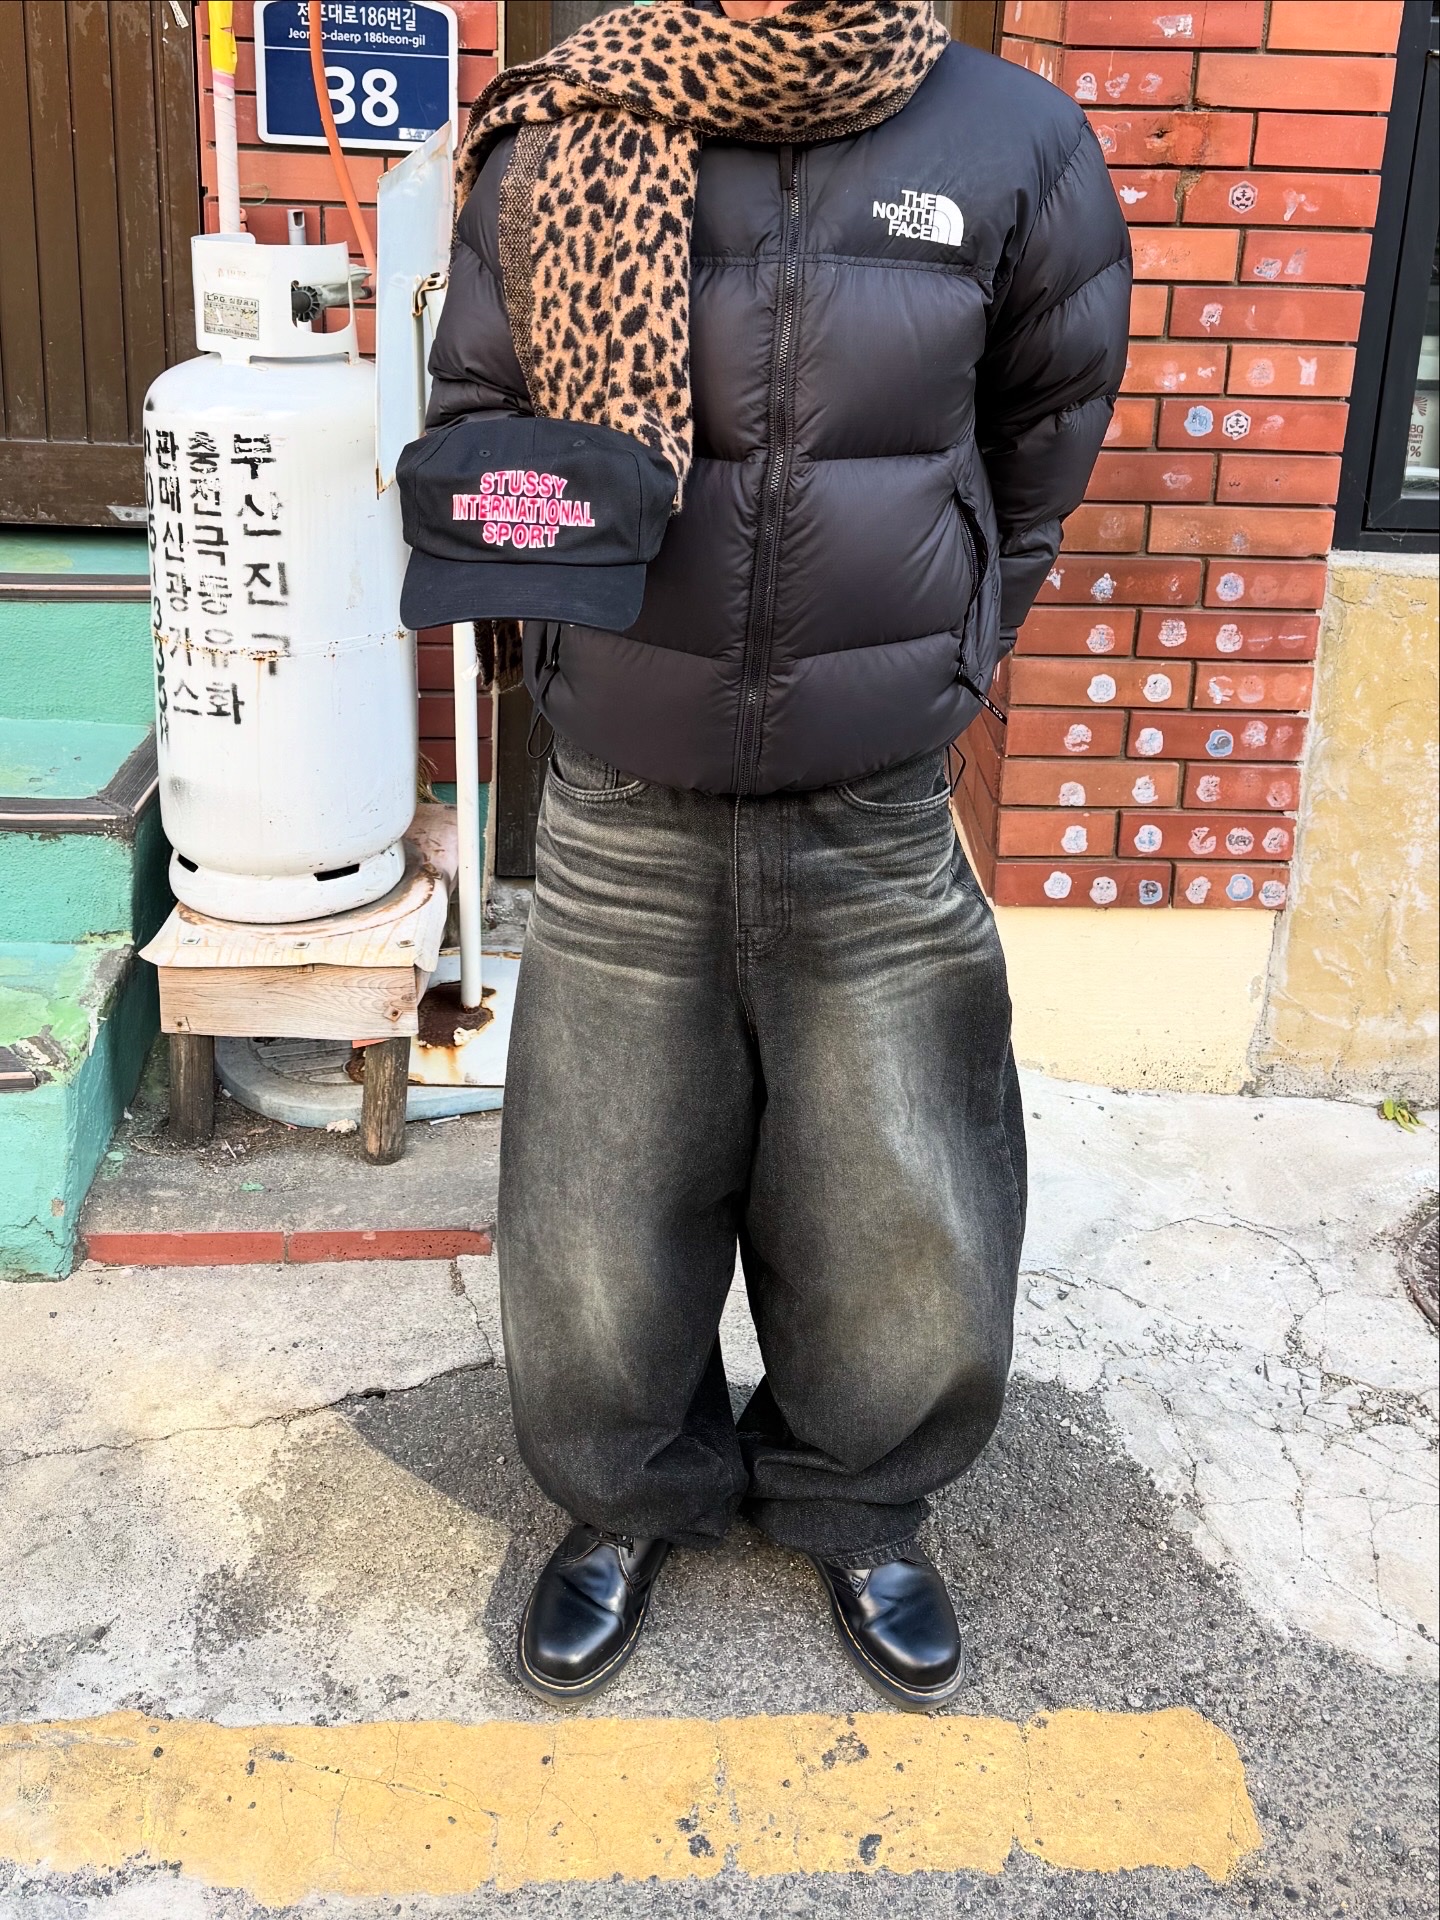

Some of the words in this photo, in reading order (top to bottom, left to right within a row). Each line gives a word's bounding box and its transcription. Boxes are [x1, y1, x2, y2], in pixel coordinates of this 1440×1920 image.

[364, 32, 426, 48] 186beon-gil
[323, 66, 400, 127] 38
[901, 190, 937, 210] THE
[873, 201, 934, 226] NORTH
[888, 220, 932, 241] FACE
[480, 470, 568, 498] STUSSY
[452, 494, 596, 527] INTERNATIONAL
[482, 522, 560, 549] SPORT
